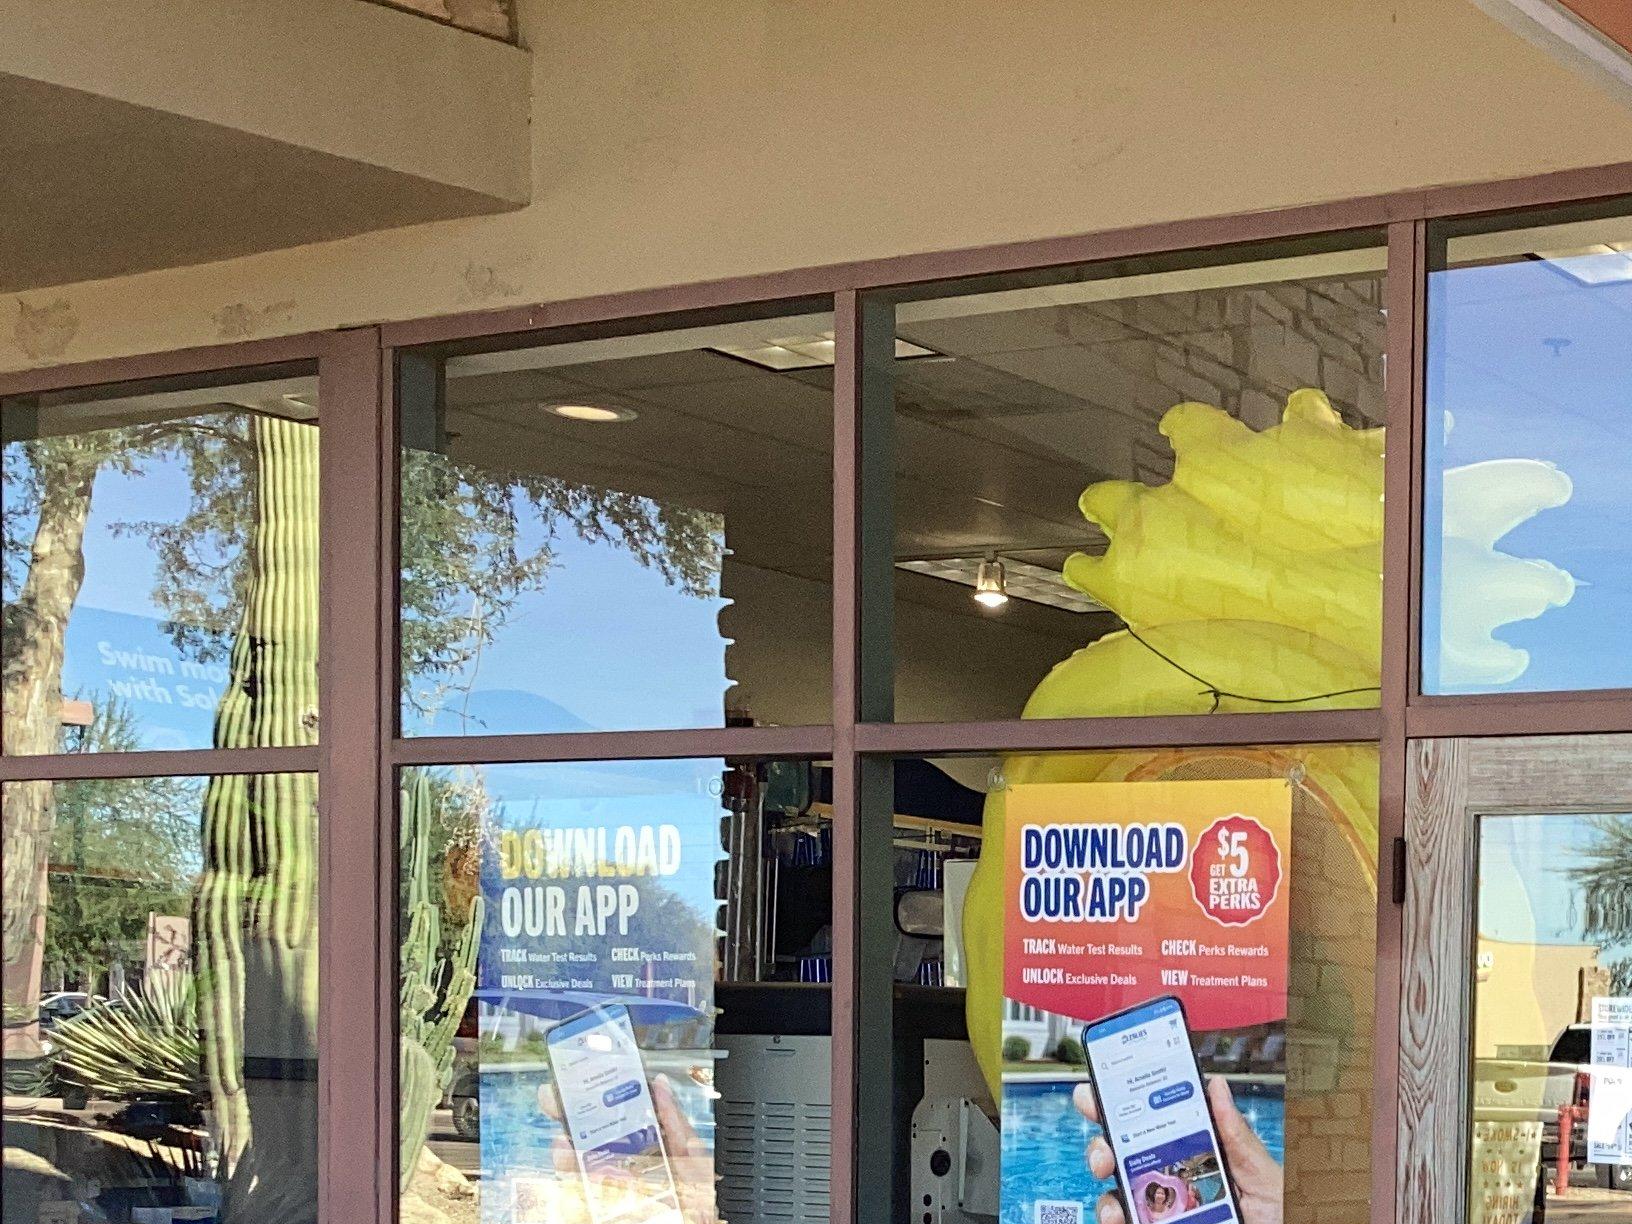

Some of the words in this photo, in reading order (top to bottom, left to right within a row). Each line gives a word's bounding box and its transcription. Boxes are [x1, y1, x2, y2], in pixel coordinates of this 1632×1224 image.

[98, 641, 174, 675] Swim
[108, 676, 173, 704] with
[501, 825, 681, 879] DOWNLOAD
[1024, 826, 1184, 869] DOWNLOAD
[1217, 826, 1249, 877] $5
[1210, 864, 1225, 877] GET
[1210, 878, 1258, 894] EXTRA
[1024, 877, 1080, 918] OUR
[1089, 876, 1146, 918] APP
[1210, 893, 1261, 910] PERKS
[501, 886, 566, 937] OUR
[575, 884, 639, 936] APP
[611, 948, 639, 962] CHECK
[663, 952, 696, 962] Rewards
[1023, 938, 1056, 955] TRACK
[1058, 944, 1085, 955] Water
[1086, 945, 1106, 956] Test
[1108, 944, 1143, 956] Results
[1161, 940, 1196, 956] CHECK
[1198, 945, 1225, 957] Perks
[1227, 945, 1269, 957] Rewards
[501, 949, 527, 963] TRACK
[501, 975, 534, 989] UNLOCK
[611, 975, 634, 988] VIEW
[1022, 968, 1064, 984] UNLOCK
[1065, 973, 1108, 985] Exclusive
[1110, 973, 1137, 986] Deals
[1161, 970, 1188, 985] VIEW
[1191, 975, 1239, 987] Treatment
[1241, 975, 1268, 987] Plans
